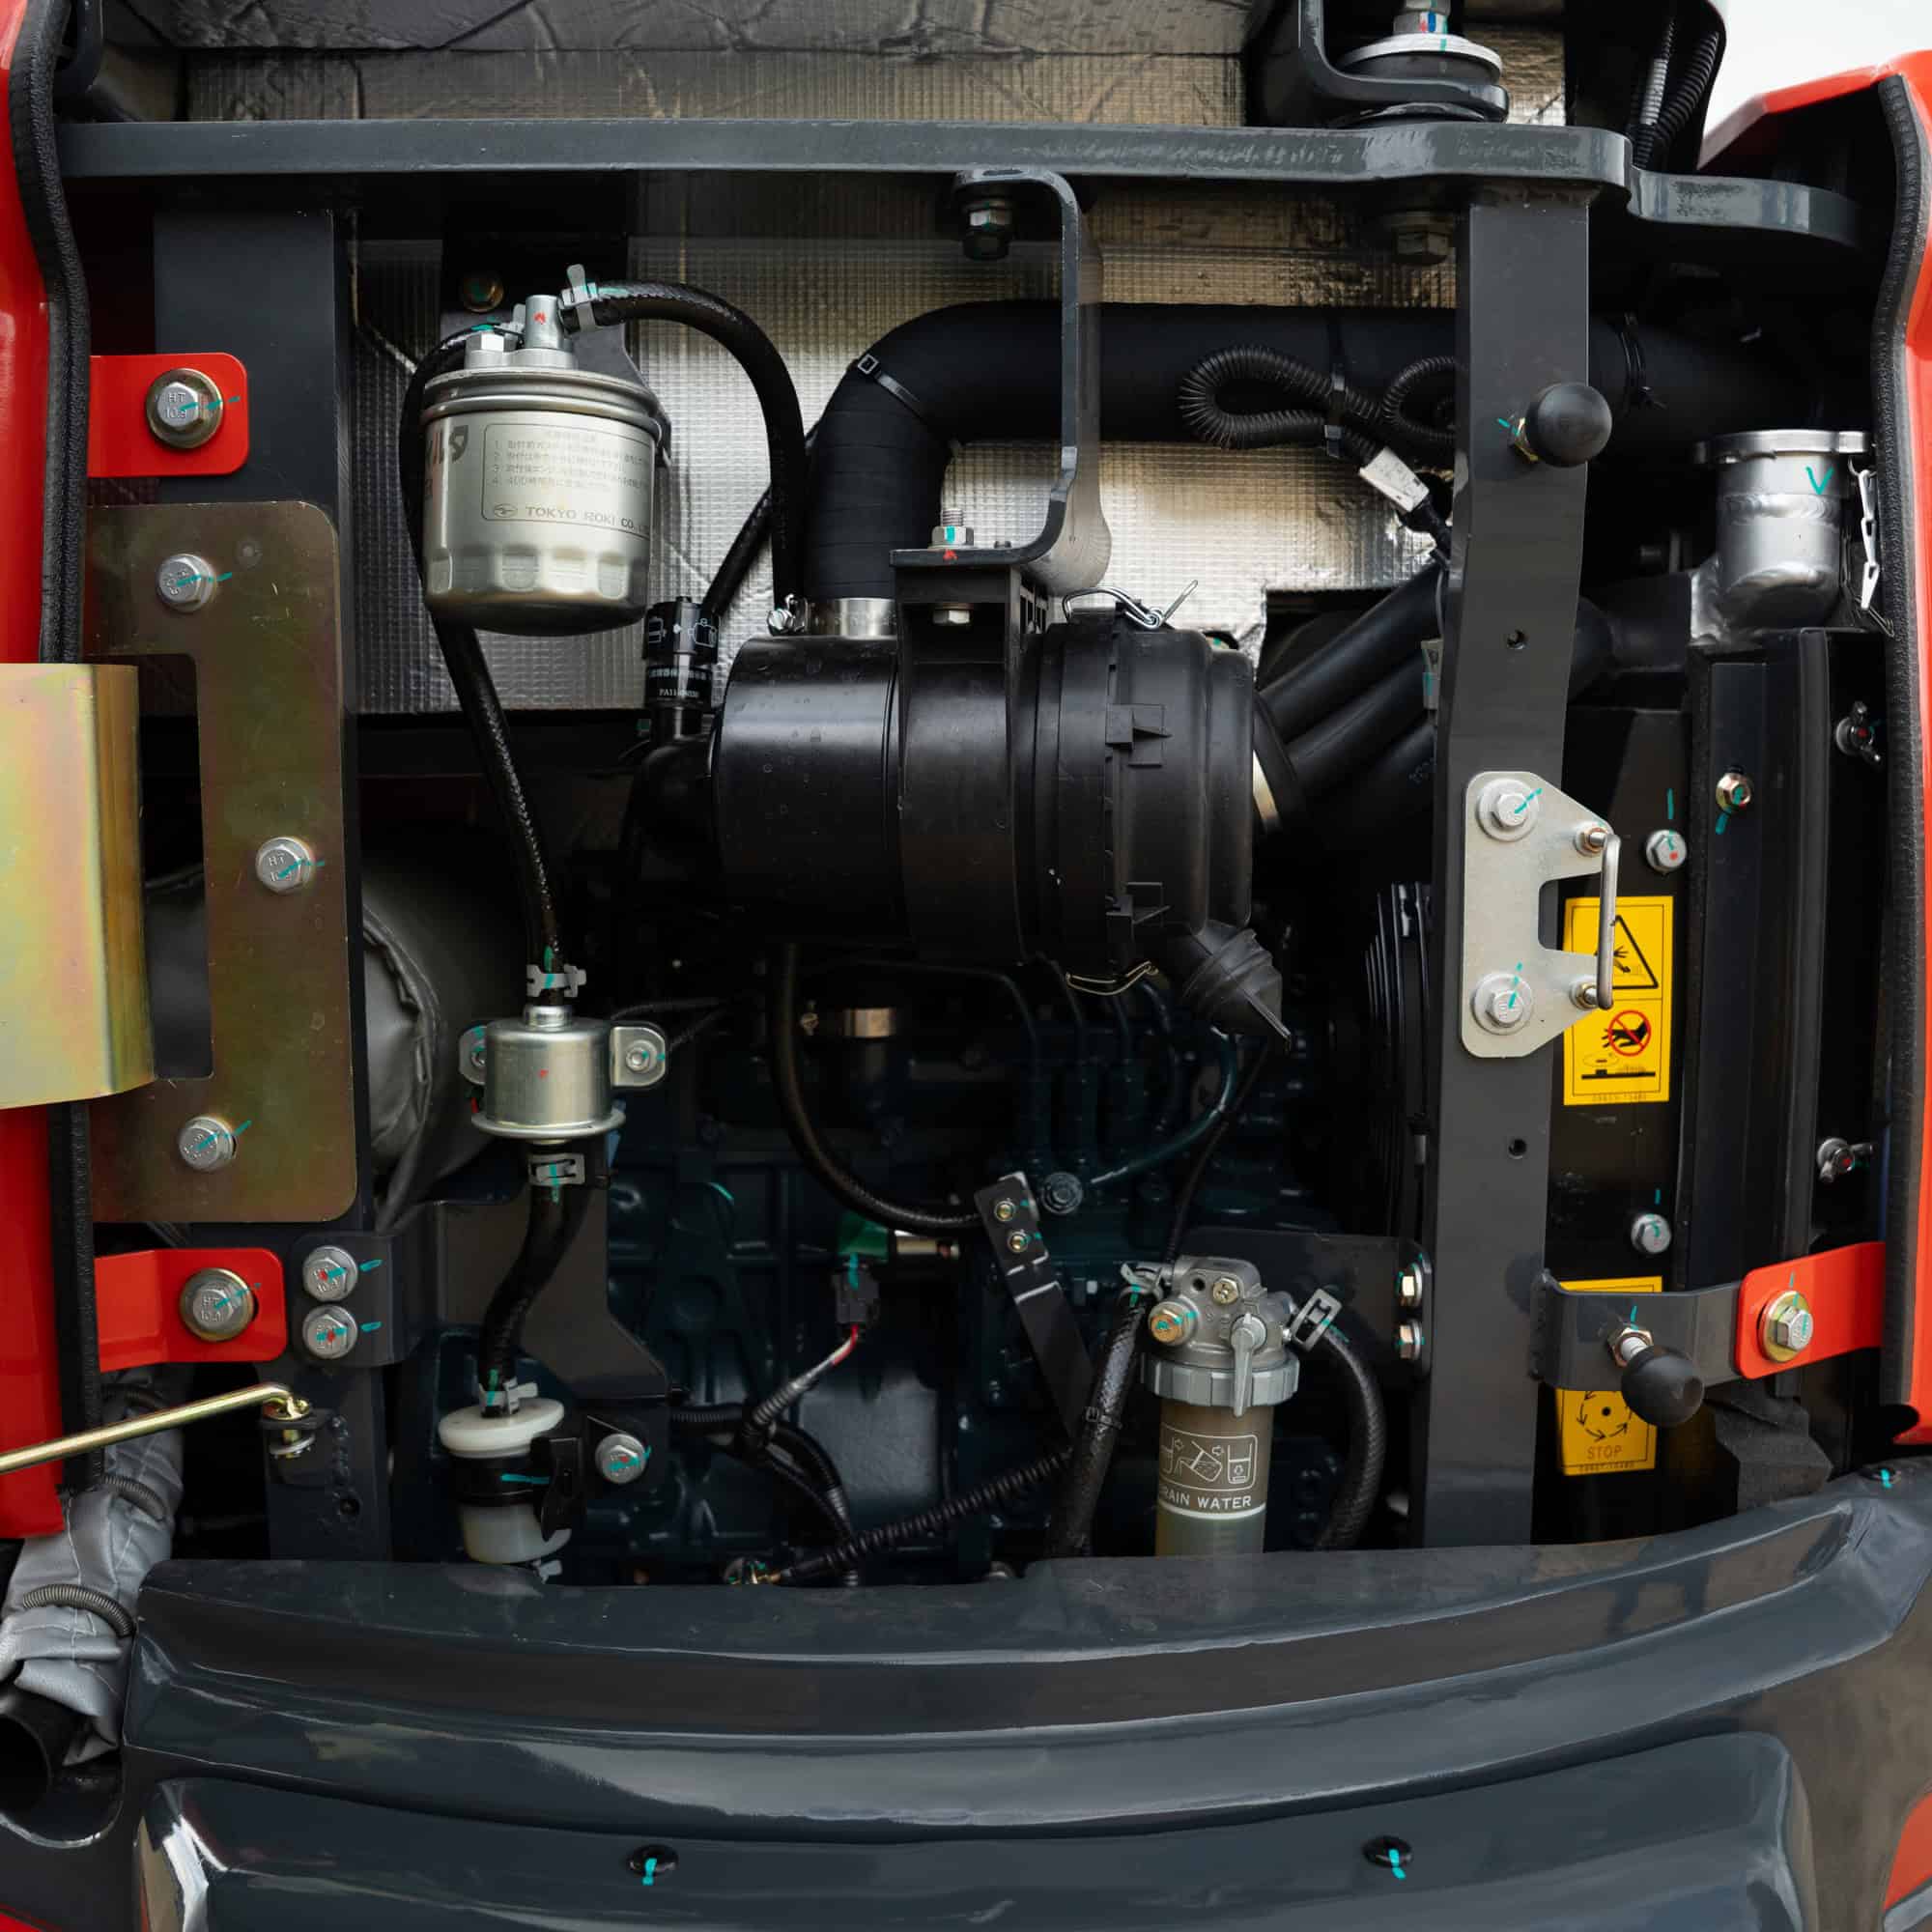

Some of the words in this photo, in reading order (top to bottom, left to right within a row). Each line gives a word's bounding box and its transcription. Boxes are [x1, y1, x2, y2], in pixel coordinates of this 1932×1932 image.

[525, 505, 578, 520] TOKYO
[584, 511, 615, 526] ROKI
[1587, 1444, 1622, 1460] STOP
[1197, 1494, 1252, 1510] WATER
